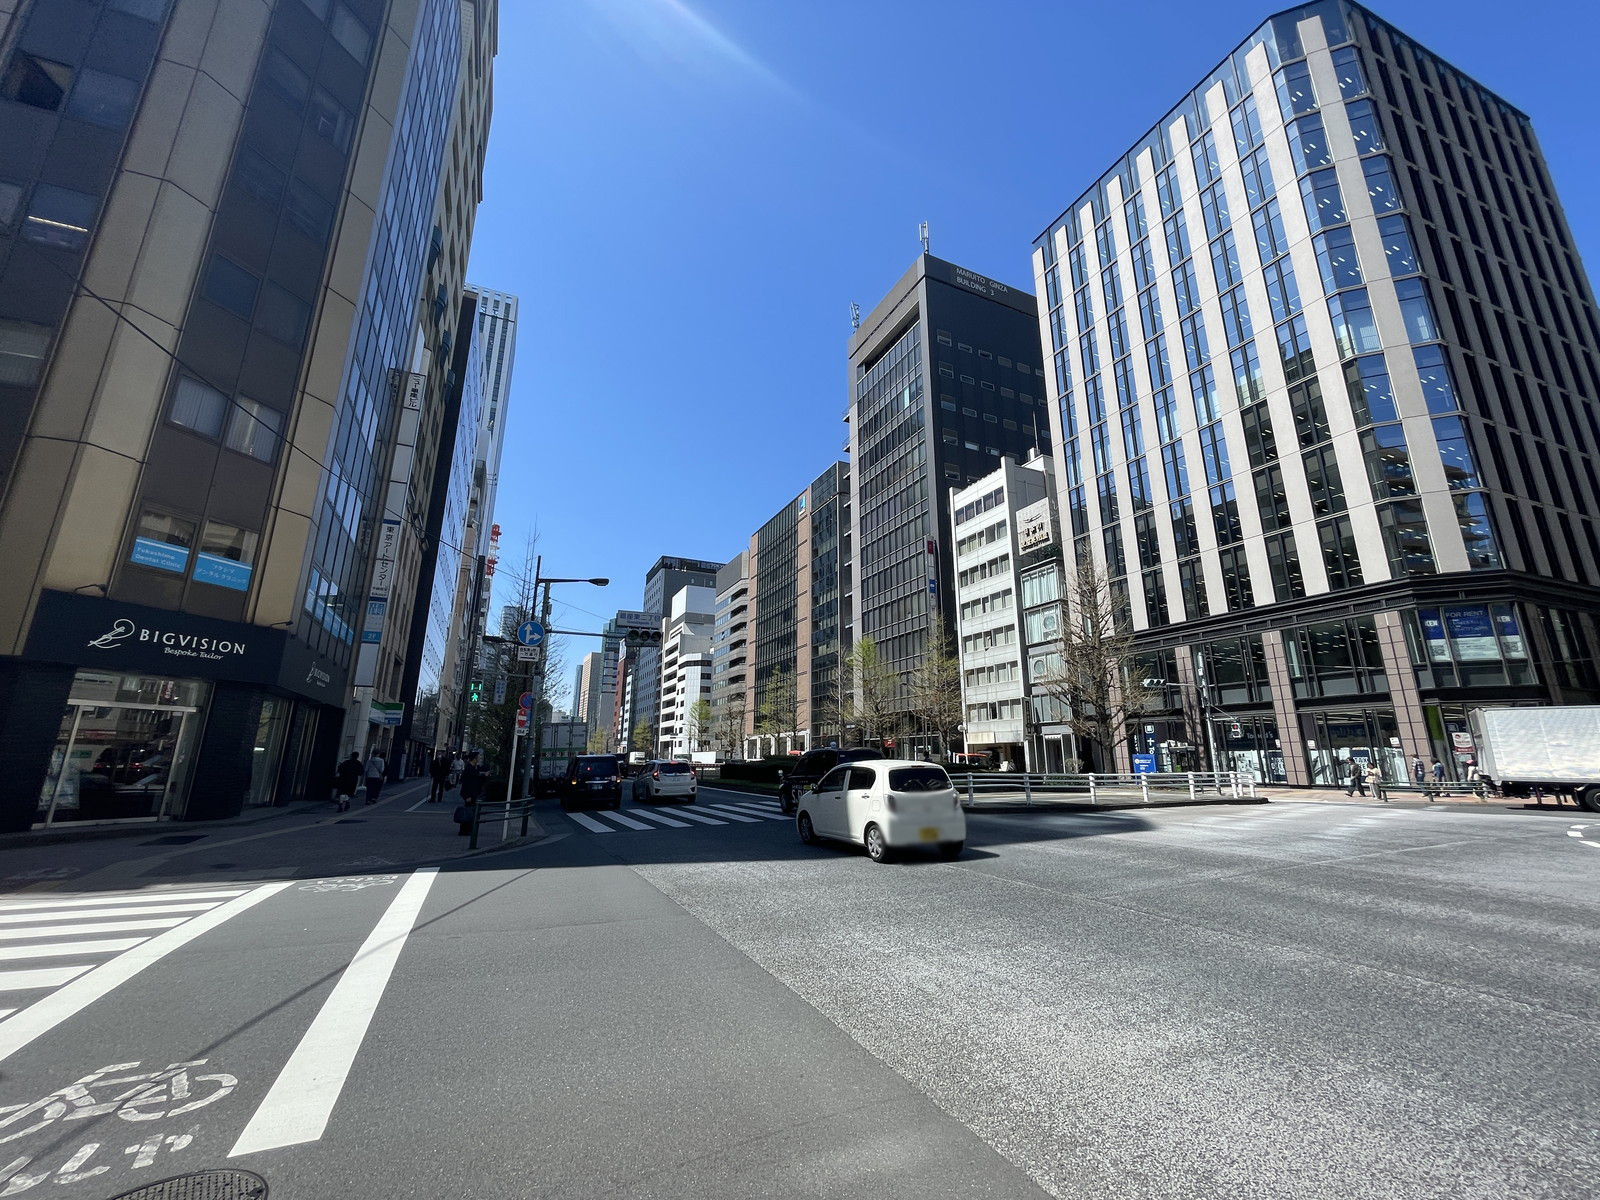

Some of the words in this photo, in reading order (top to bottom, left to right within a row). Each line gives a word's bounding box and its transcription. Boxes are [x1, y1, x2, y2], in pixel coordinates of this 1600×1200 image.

[956, 267, 986, 284] MARUITO
[989, 280, 1008, 293] GINZA
[956, 276, 987, 293] BUILDING
[135, 553, 159, 563] Dental
[161, 559, 181, 569] Clinic
[377, 526, 395, 586] 東京アートセンター
[139, 628, 246, 656] BIGVISION
[164, 646, 198, 658] Bespoke
[199, 650, 224, 661] Tailor
